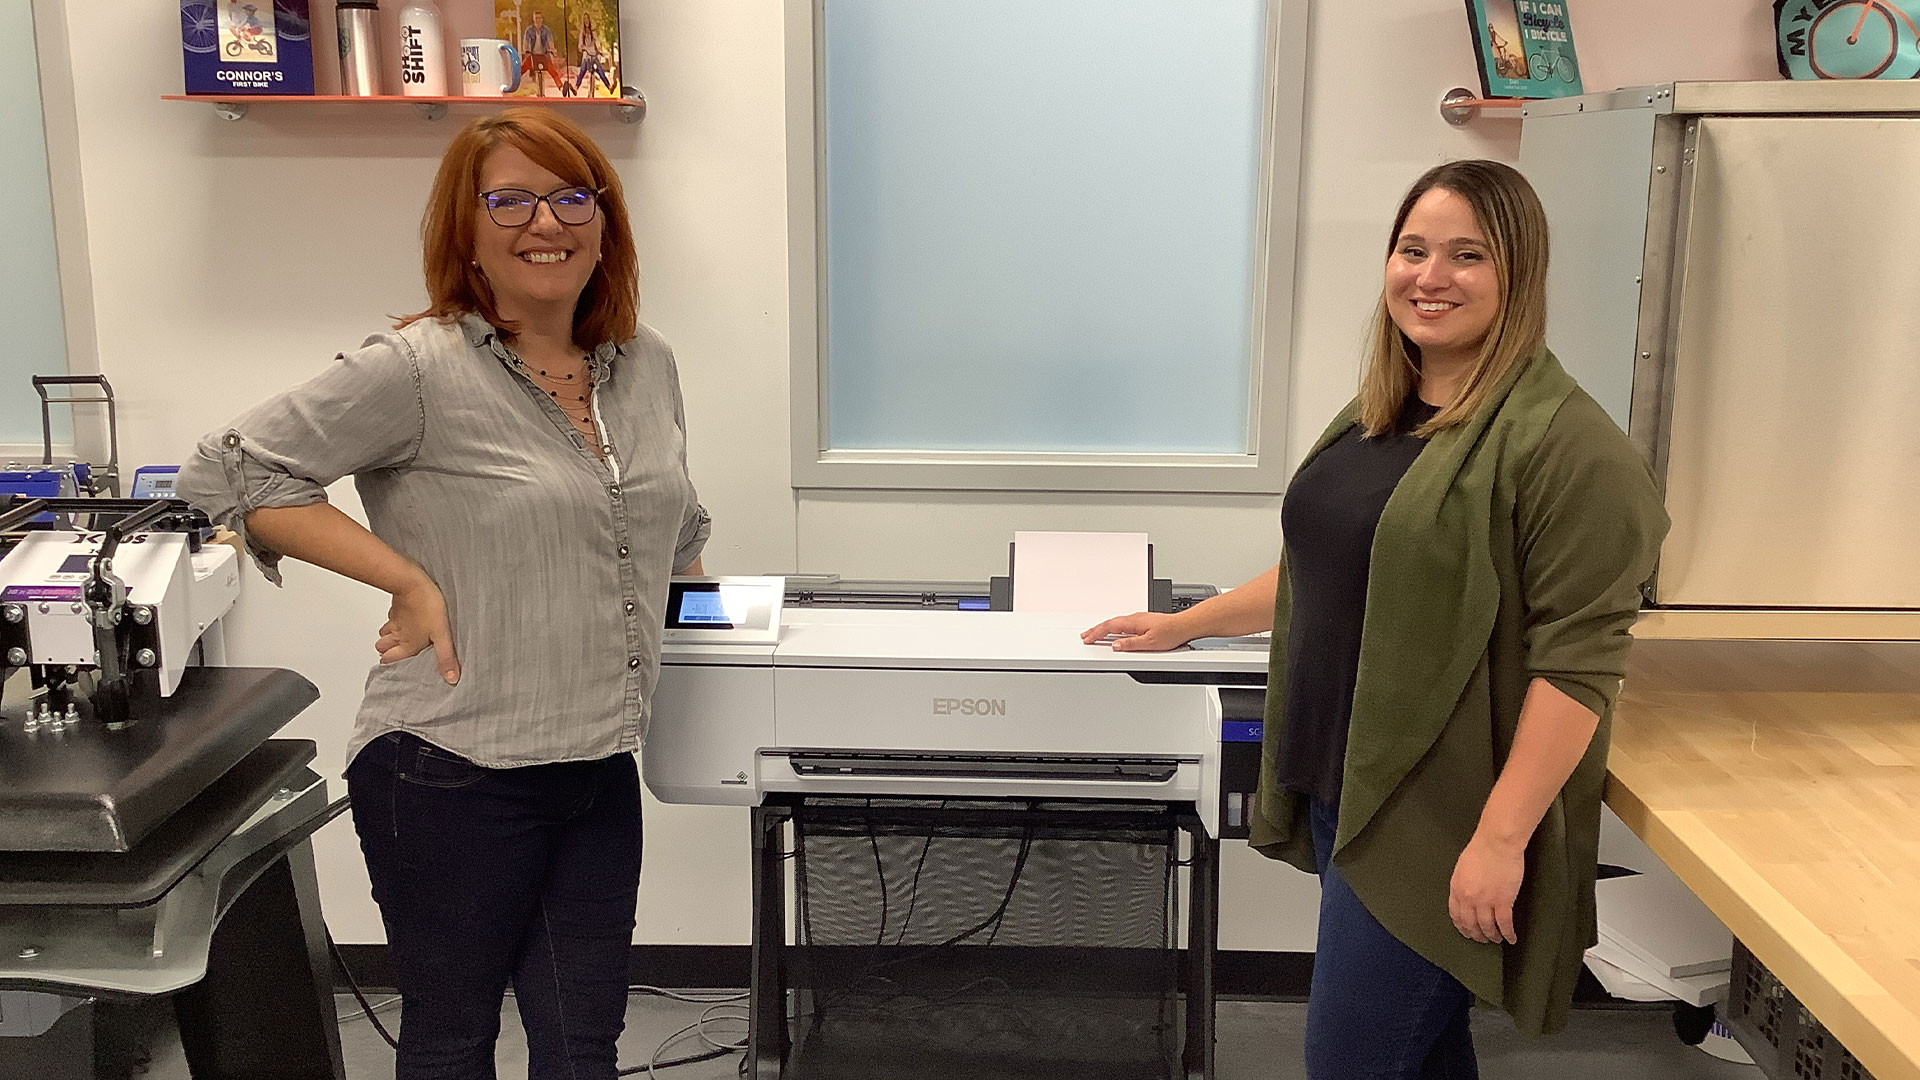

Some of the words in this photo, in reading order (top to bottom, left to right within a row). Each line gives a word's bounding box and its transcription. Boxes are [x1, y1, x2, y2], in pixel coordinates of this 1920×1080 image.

[1520, 1, 1531, 13] IF
[1533, 2, 1537, 13] I
[1540, 3, 1562, 16] CAN
[1525, 29, 1529, 39] I
[1531, 29, 1567, 42] BICYCLE
[408, 25, 426, 84] SHIFT
[216, 70, 284, 82] CONNOR'S
[932, 698, 1006, 716] EPSON
